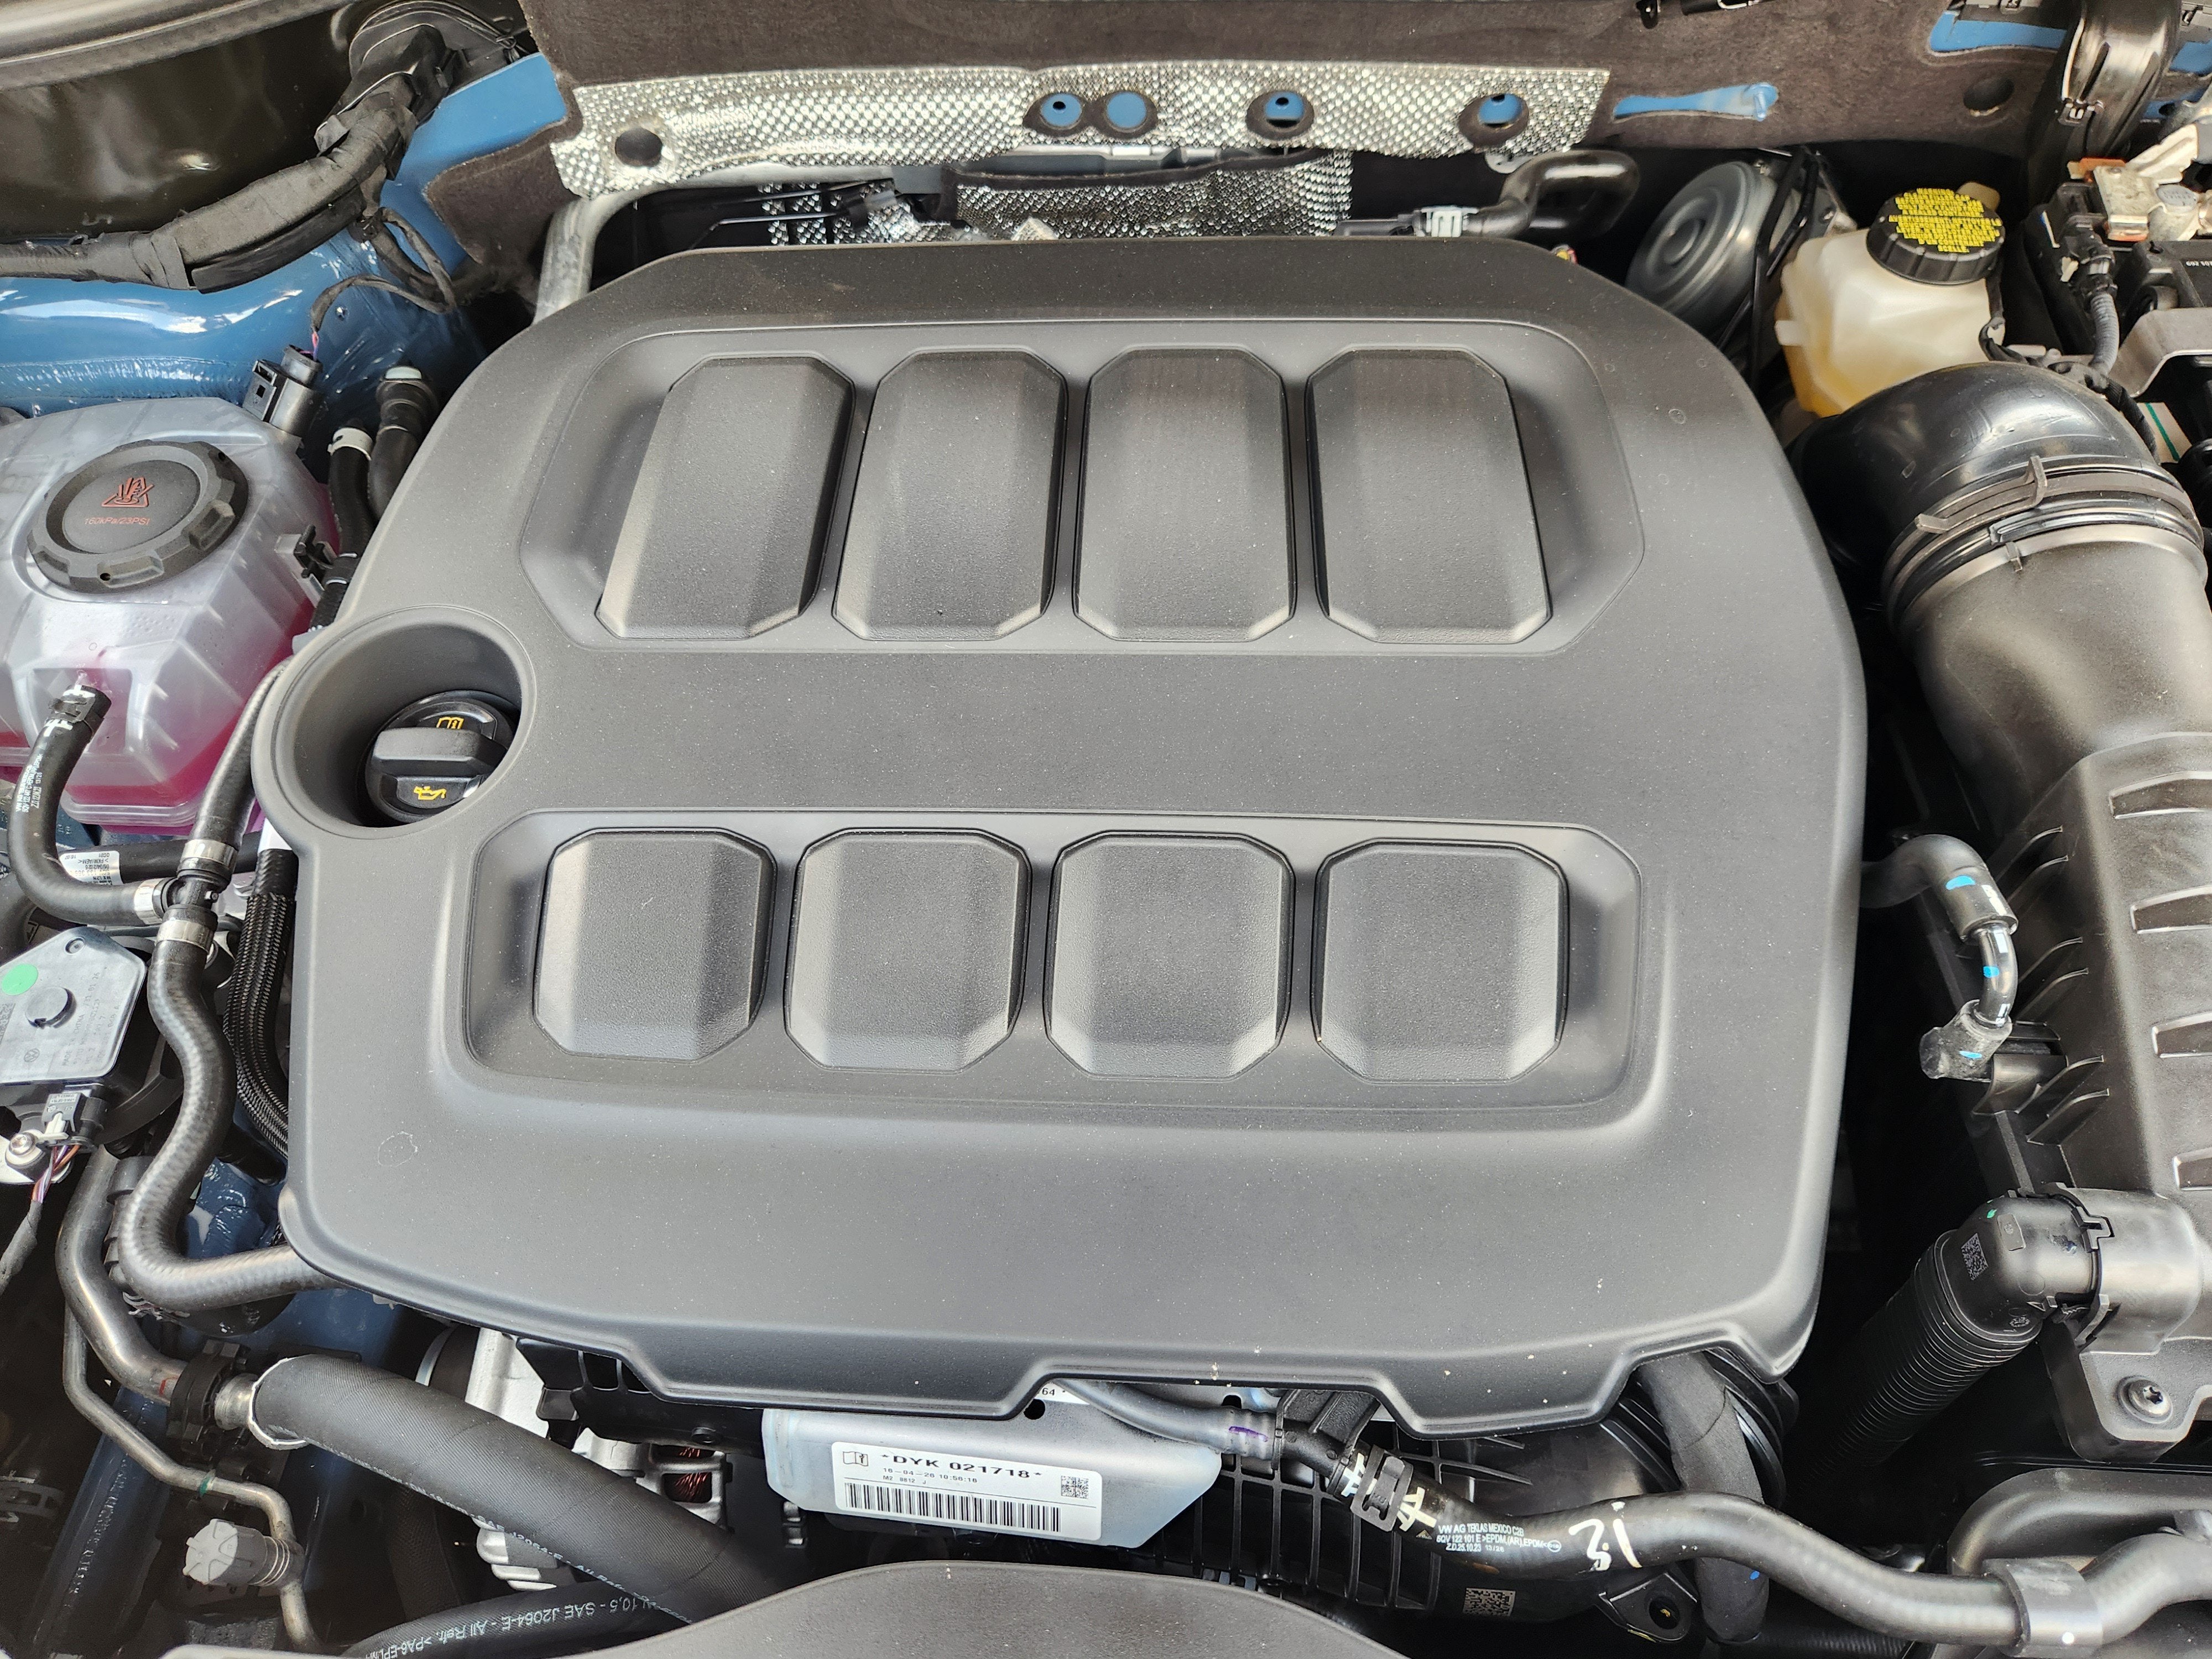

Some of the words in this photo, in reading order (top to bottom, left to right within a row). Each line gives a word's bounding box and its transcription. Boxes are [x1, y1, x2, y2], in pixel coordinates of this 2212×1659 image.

[1438, 1525, 1452, 1533] VW
[1453, 1523, 1465, 1533] AG
[1467, 1522, 1488, 1534] TEKLAS
[1488, 1523, 1512, 1535] MEXICO
[1452, 1535, 1462, 1543] 122
[1464, 1535, 1474, 1543] 101
[500, 1606, 561, 1631] J2064-E
[565, 1601, 596, 1620] SAE
[469, 1620, 490, 1638] All
